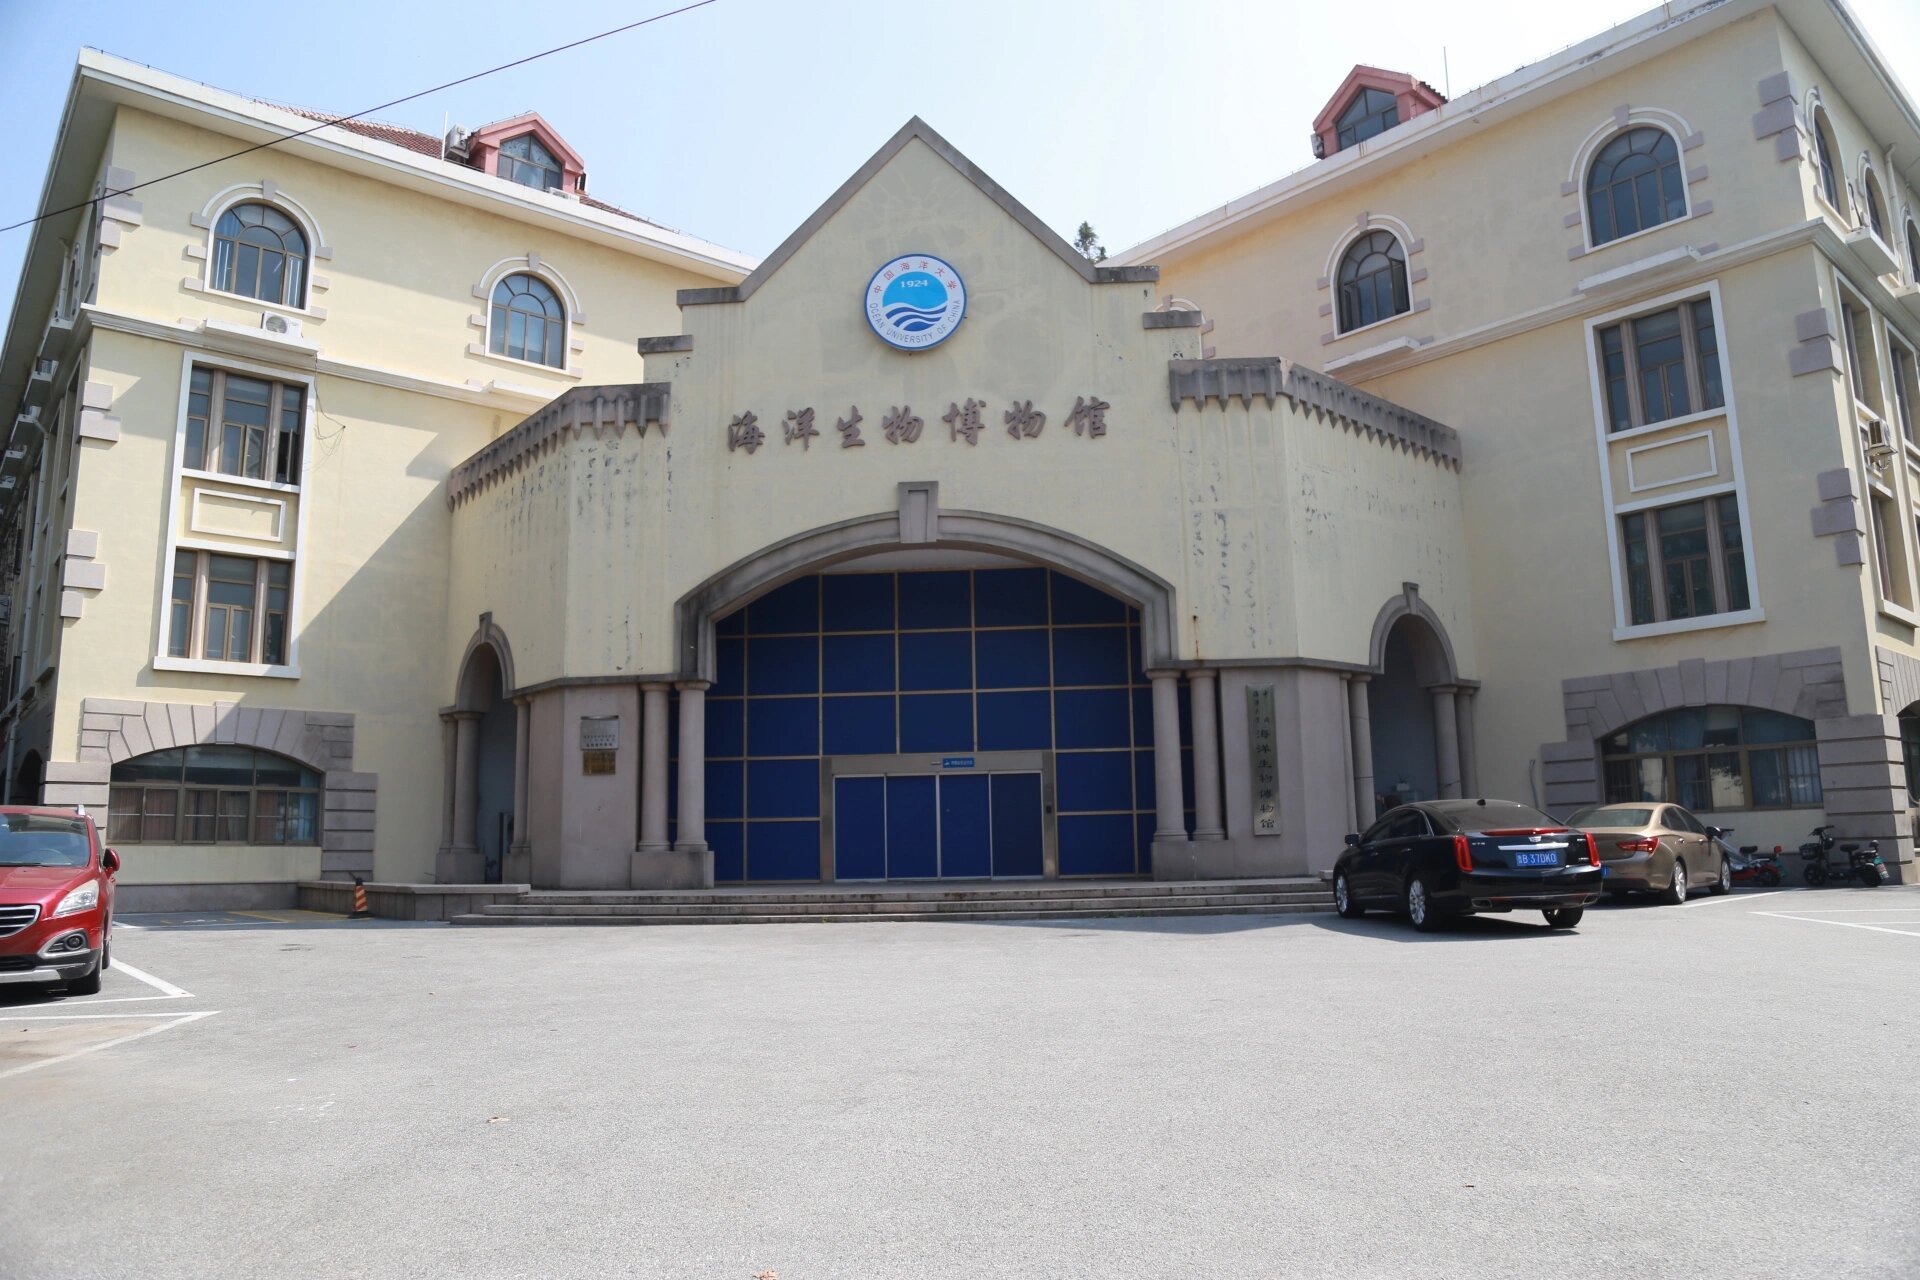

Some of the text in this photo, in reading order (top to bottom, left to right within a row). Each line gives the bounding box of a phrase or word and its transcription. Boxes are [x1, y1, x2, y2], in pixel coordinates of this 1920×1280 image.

[874, 260, 957, 294] 中国海洋大学
[900, 279, 928, 289] 1924
[870, 299, 961, 343] OCEAN UNIVERSITY OF CHINA
[728, 396, 1110, 455] 海洋生物博物馆
